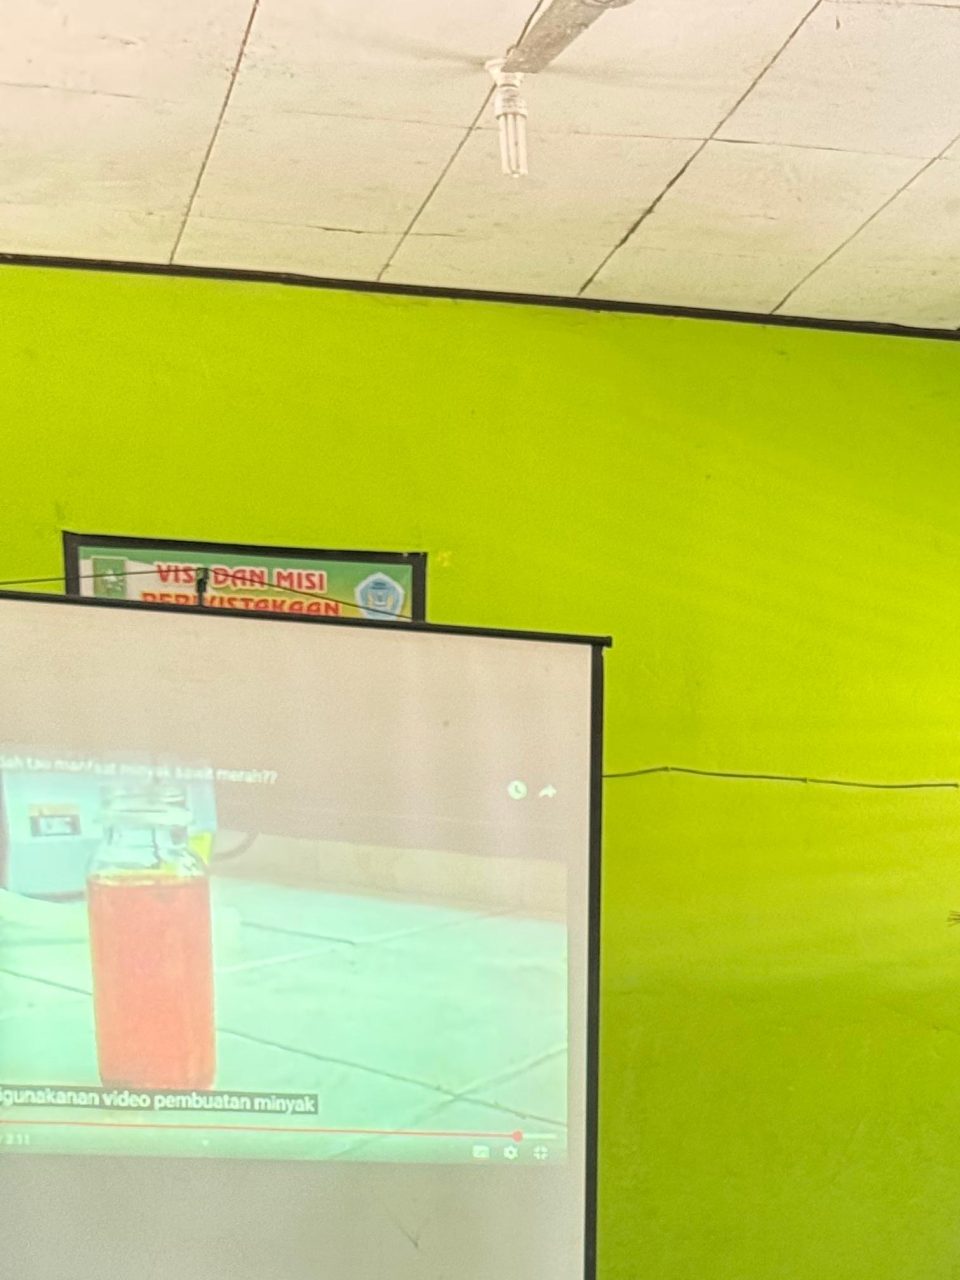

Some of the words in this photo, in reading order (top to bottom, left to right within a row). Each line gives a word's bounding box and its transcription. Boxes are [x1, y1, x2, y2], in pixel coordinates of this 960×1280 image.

[156, 564, 197, 584] VIS
[212, 567, 265, 588] DAN
[276, 570, 326, 591] MISI
[102, 1089, 151, 1107] video
[153, 1091, 252, 1111] pembuatan
[253, 1094, 316, 1114] minyak
